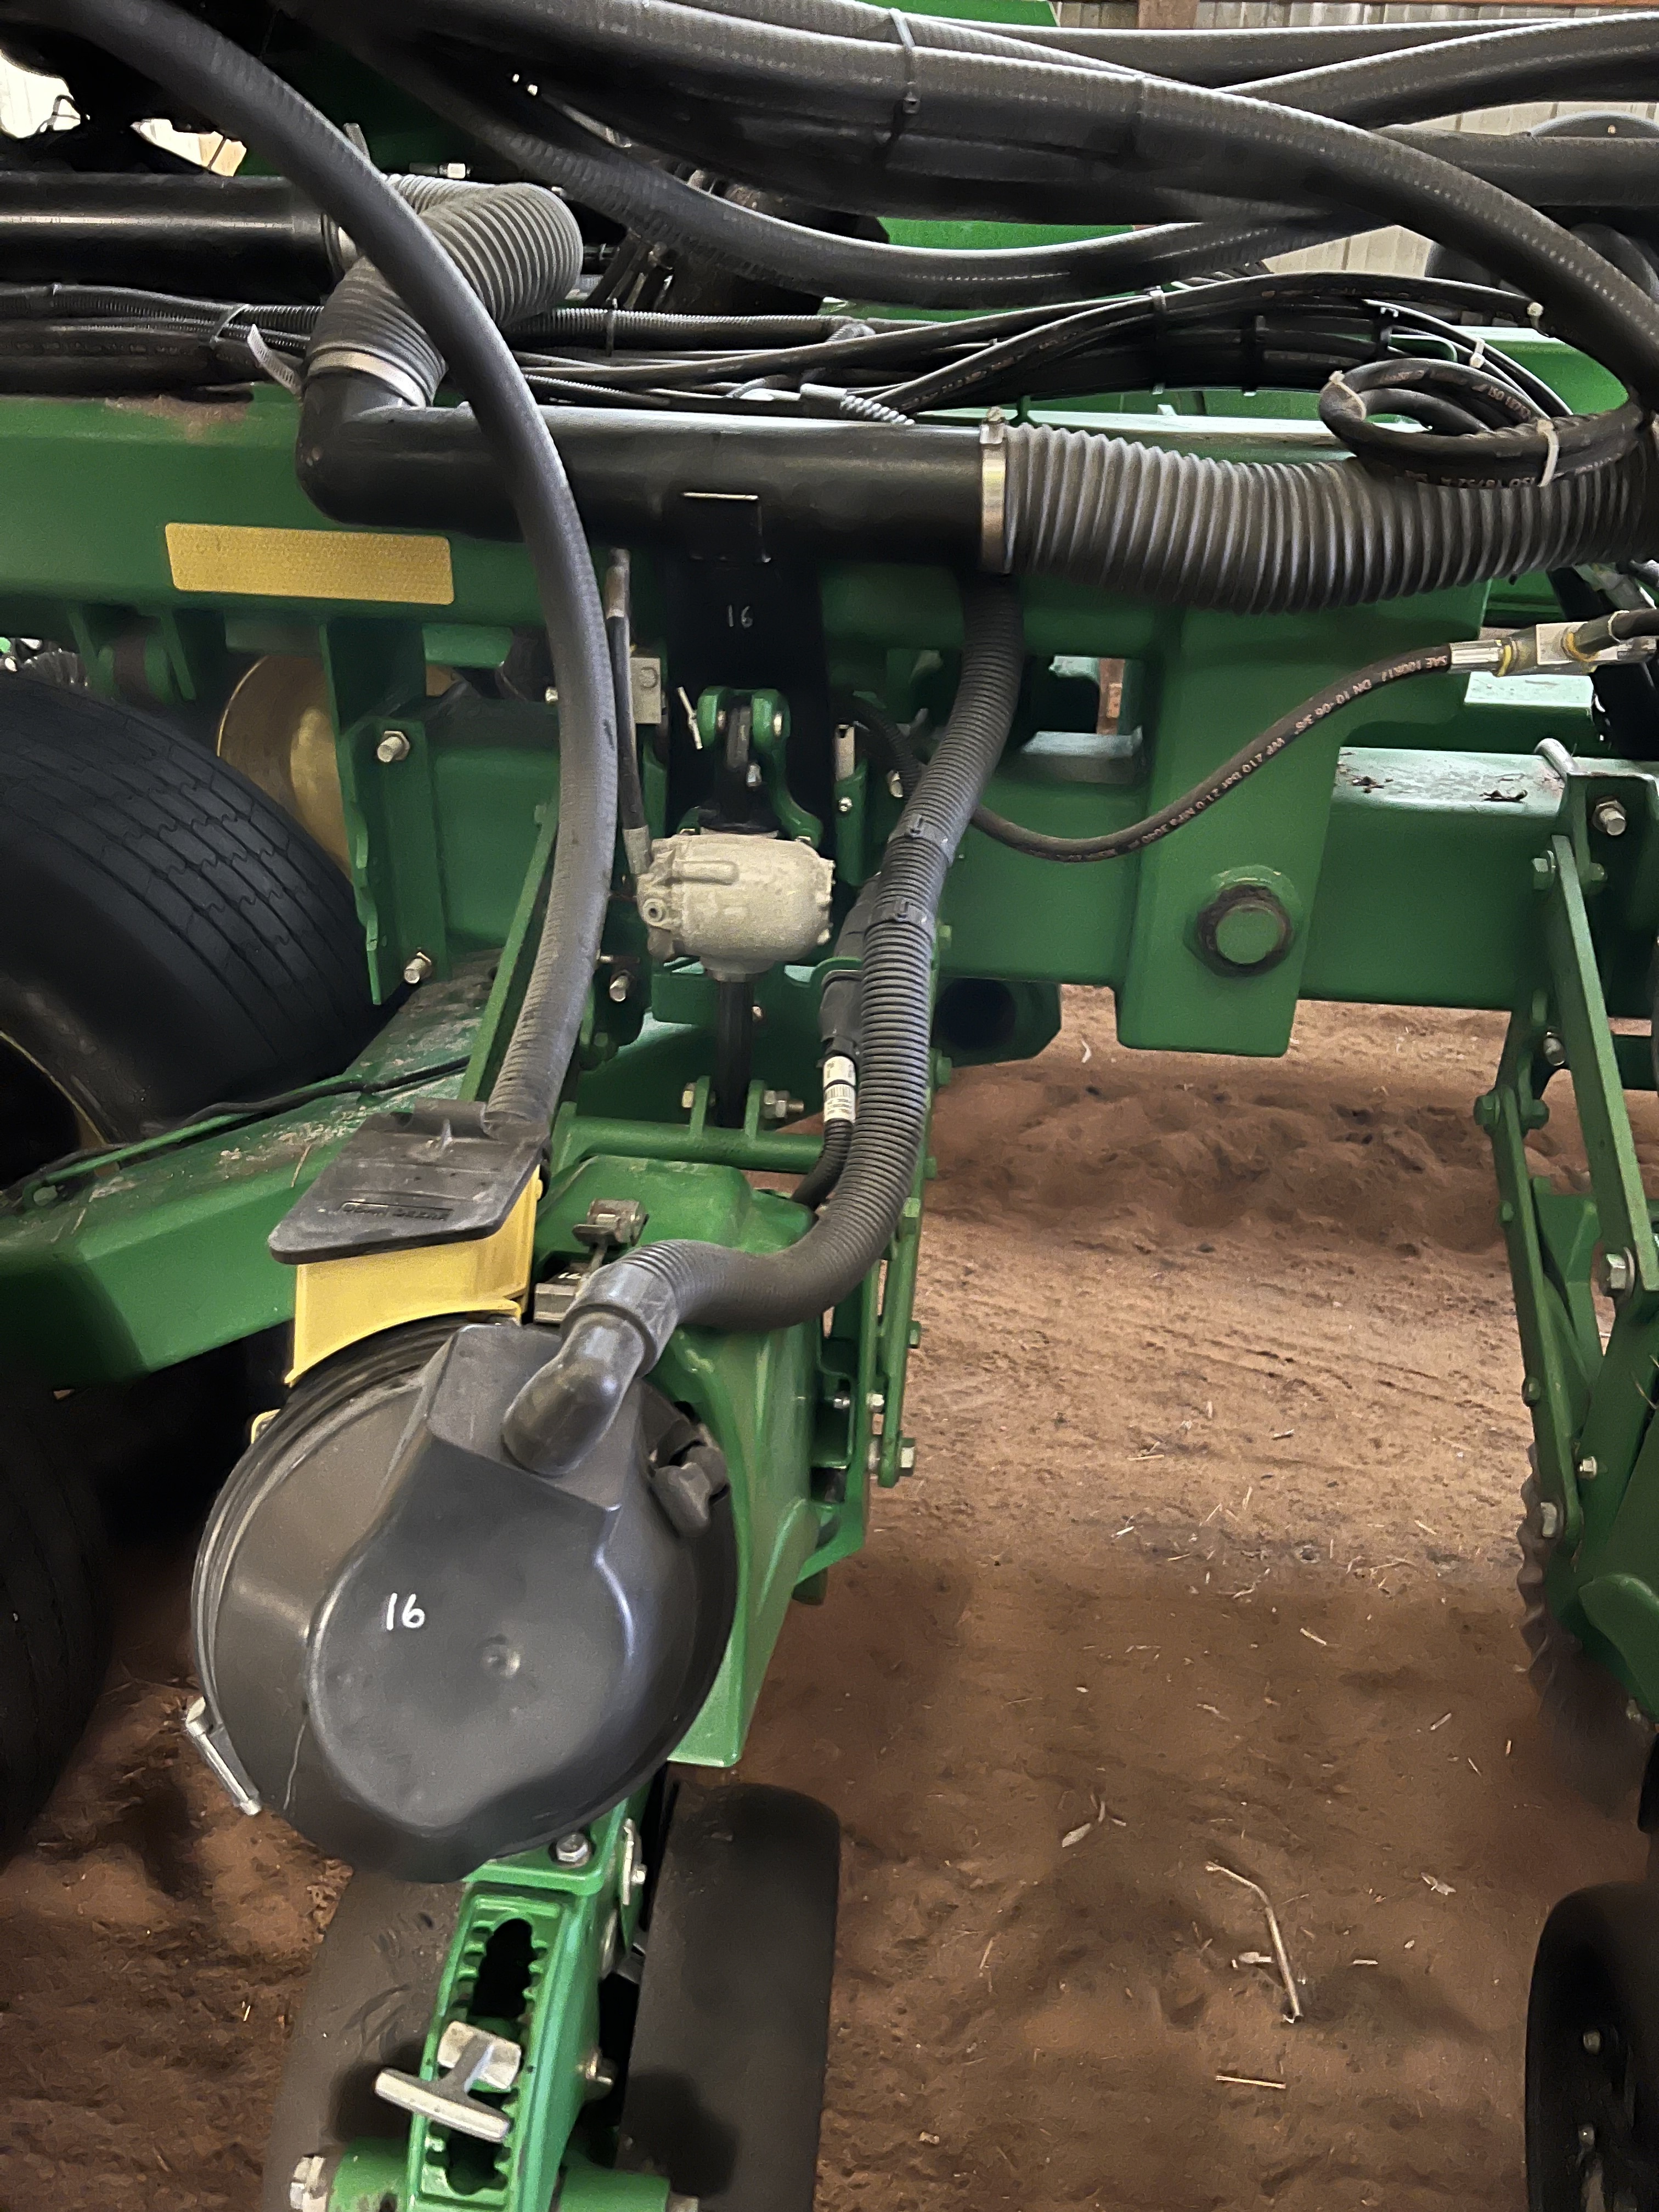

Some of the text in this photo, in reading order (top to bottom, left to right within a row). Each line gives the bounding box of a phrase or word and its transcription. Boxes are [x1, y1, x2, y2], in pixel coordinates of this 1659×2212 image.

[729, 605, 753, 628] 16
[1353, 679, 1372, 695] DN
[1336, 691, 1350, 704] 10
[386, 1593, 425, 1630] 16
